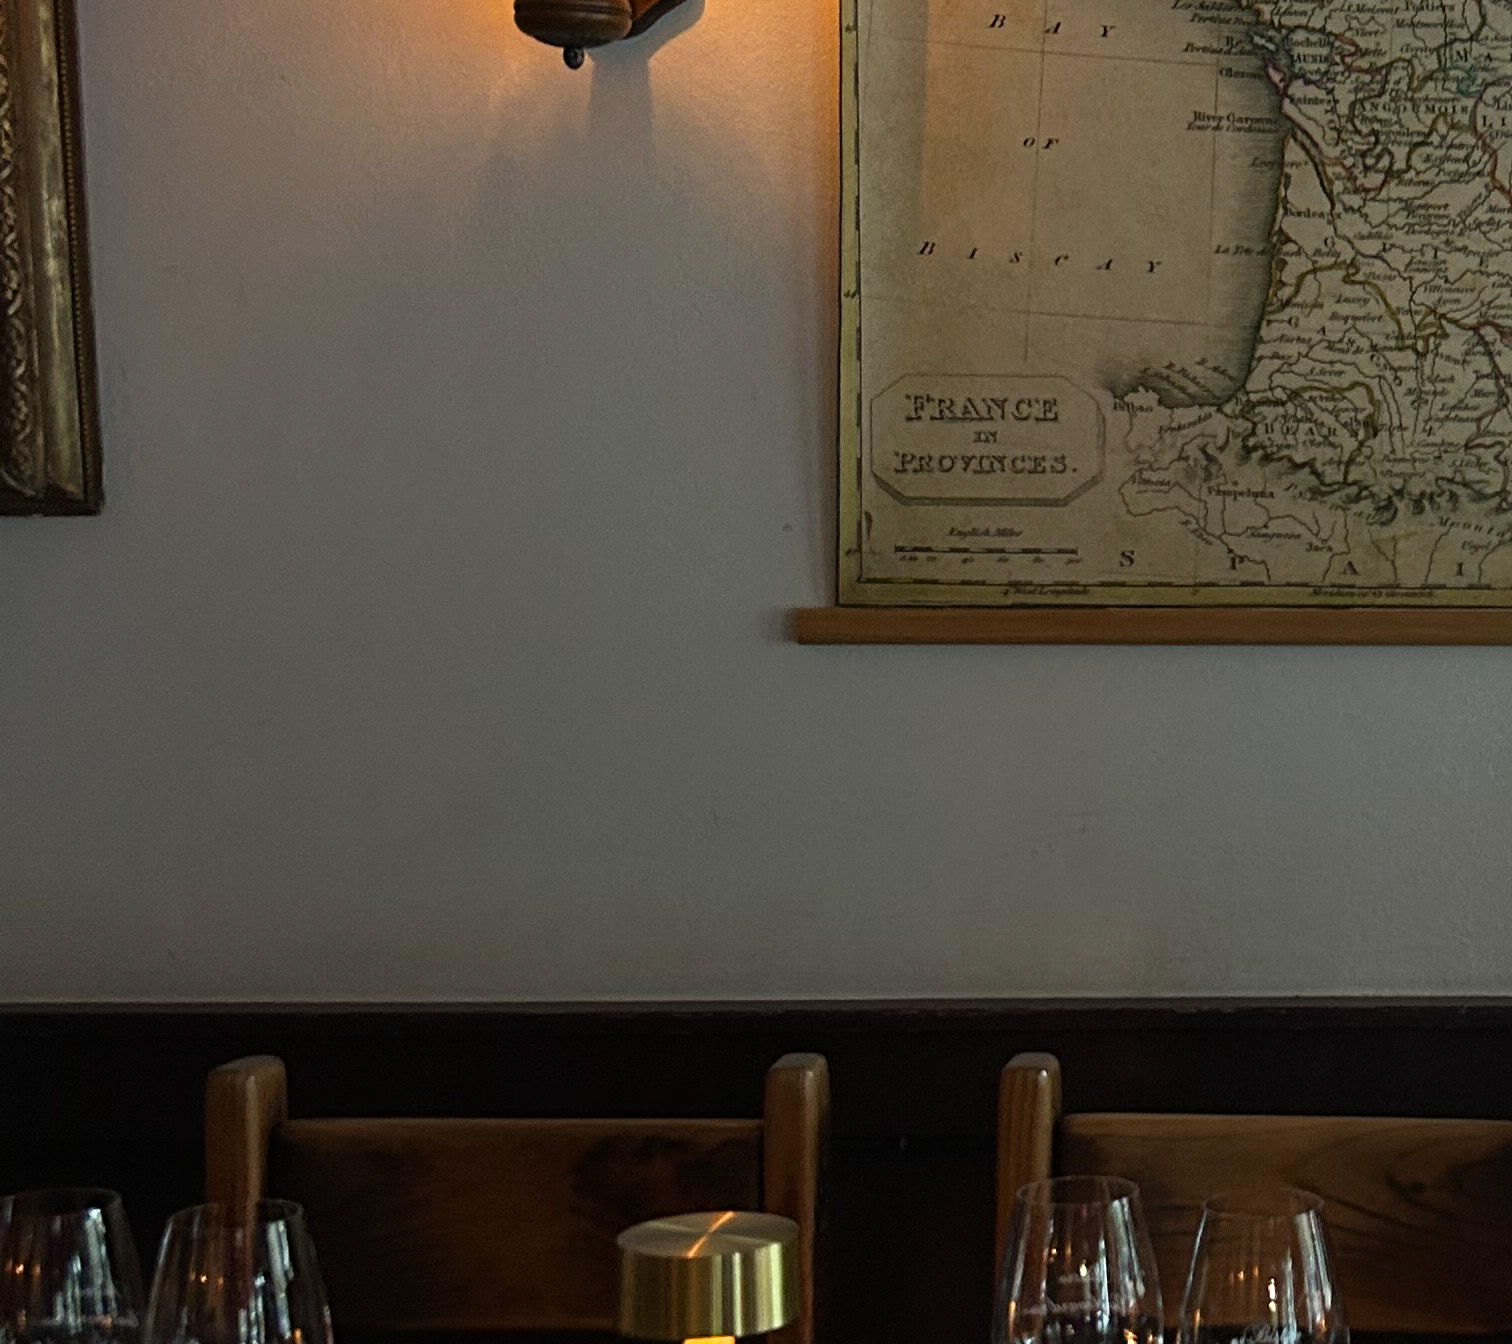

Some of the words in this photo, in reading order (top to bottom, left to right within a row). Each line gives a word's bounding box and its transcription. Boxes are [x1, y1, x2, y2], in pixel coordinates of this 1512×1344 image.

[987, 12, 1117, 39] BAY
[1021, 136, 1061, 151] OF
[917, 240, 1162, 274] BISCAY
[904, 394, 1058, 422] FRANCE
[973, 430, 998, 443] IN
[894, 451, 1078, 474] PROVINCES.
